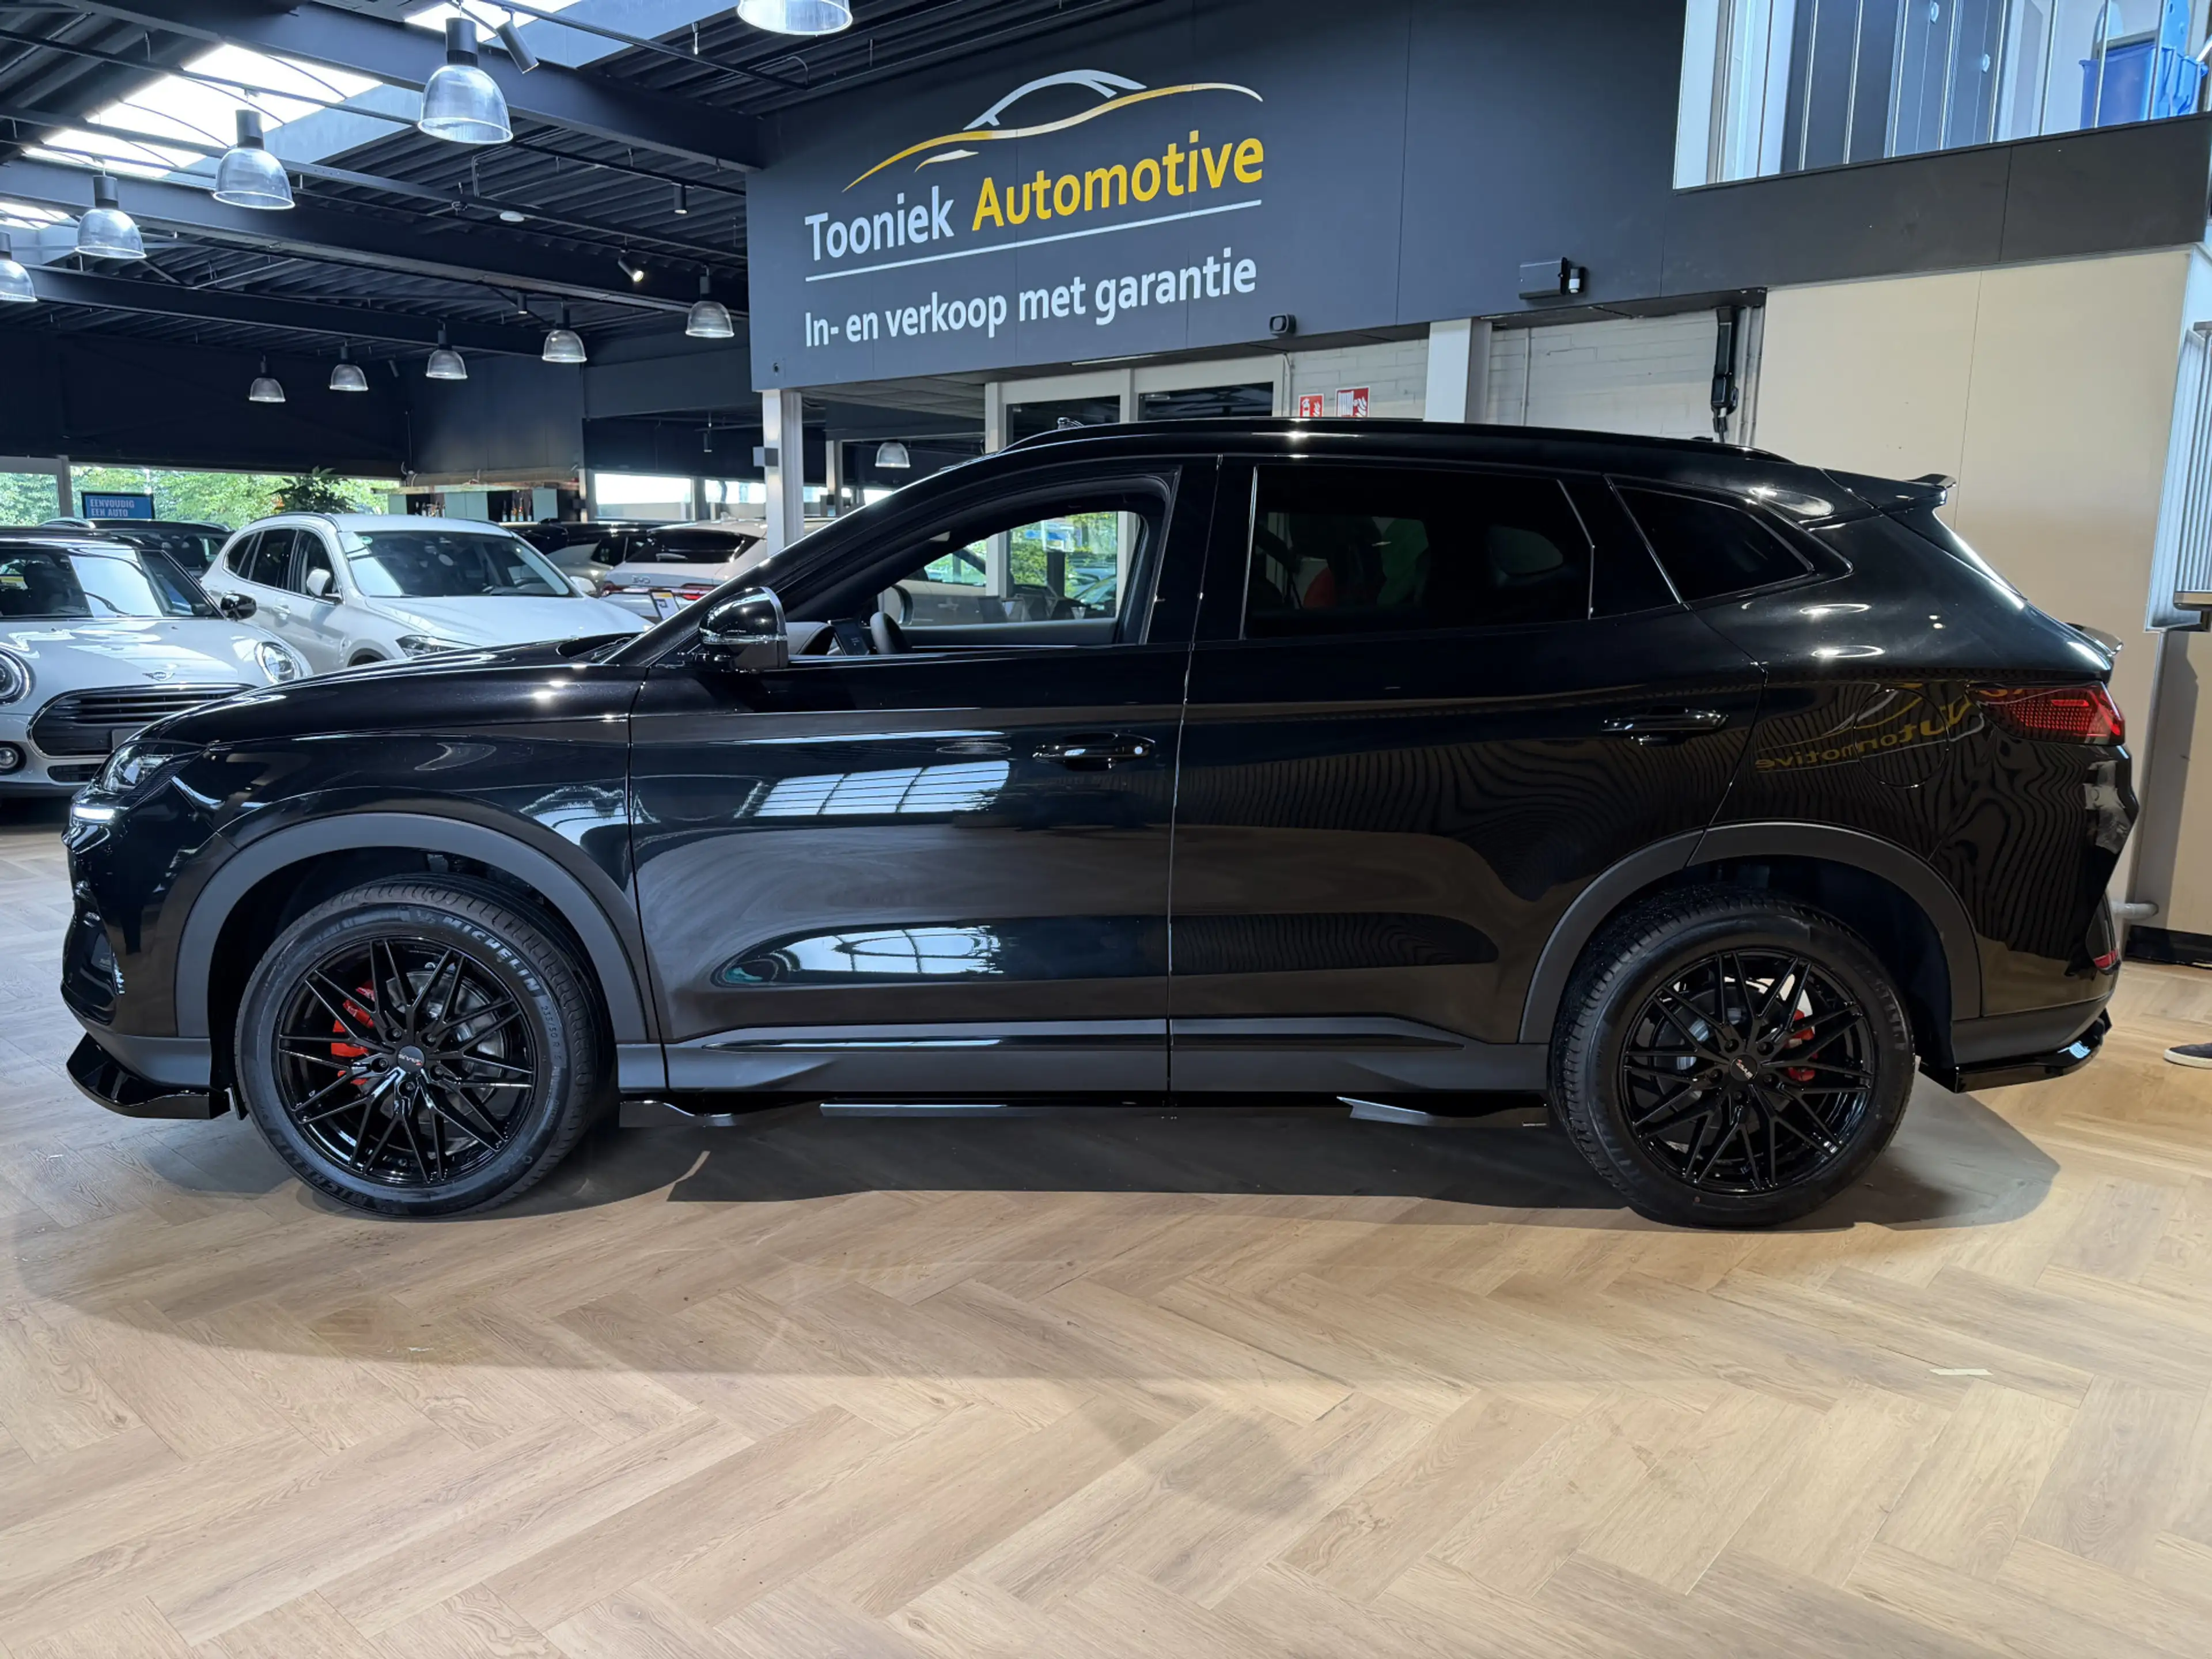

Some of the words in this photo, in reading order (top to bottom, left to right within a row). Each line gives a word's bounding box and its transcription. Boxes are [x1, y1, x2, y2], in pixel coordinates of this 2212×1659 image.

[804, 184, 955, 262] Tooniek
[972, 130, 1264, 232] Automotive
[805, 312, 839, 347] In-
[846, 312, 879, 343] en
[885, 291, 1007, 338] verkoop
[1019, 276, 1086, 321] met
[1095, 248, 1257, 326] garantie
[90, 499, 135, 508] EENVOUDIG
[91, 508, 105, 517] EEN
[108, 509, 128, 517] AUTO
[442, 916, 541, 992] MICHELIN
